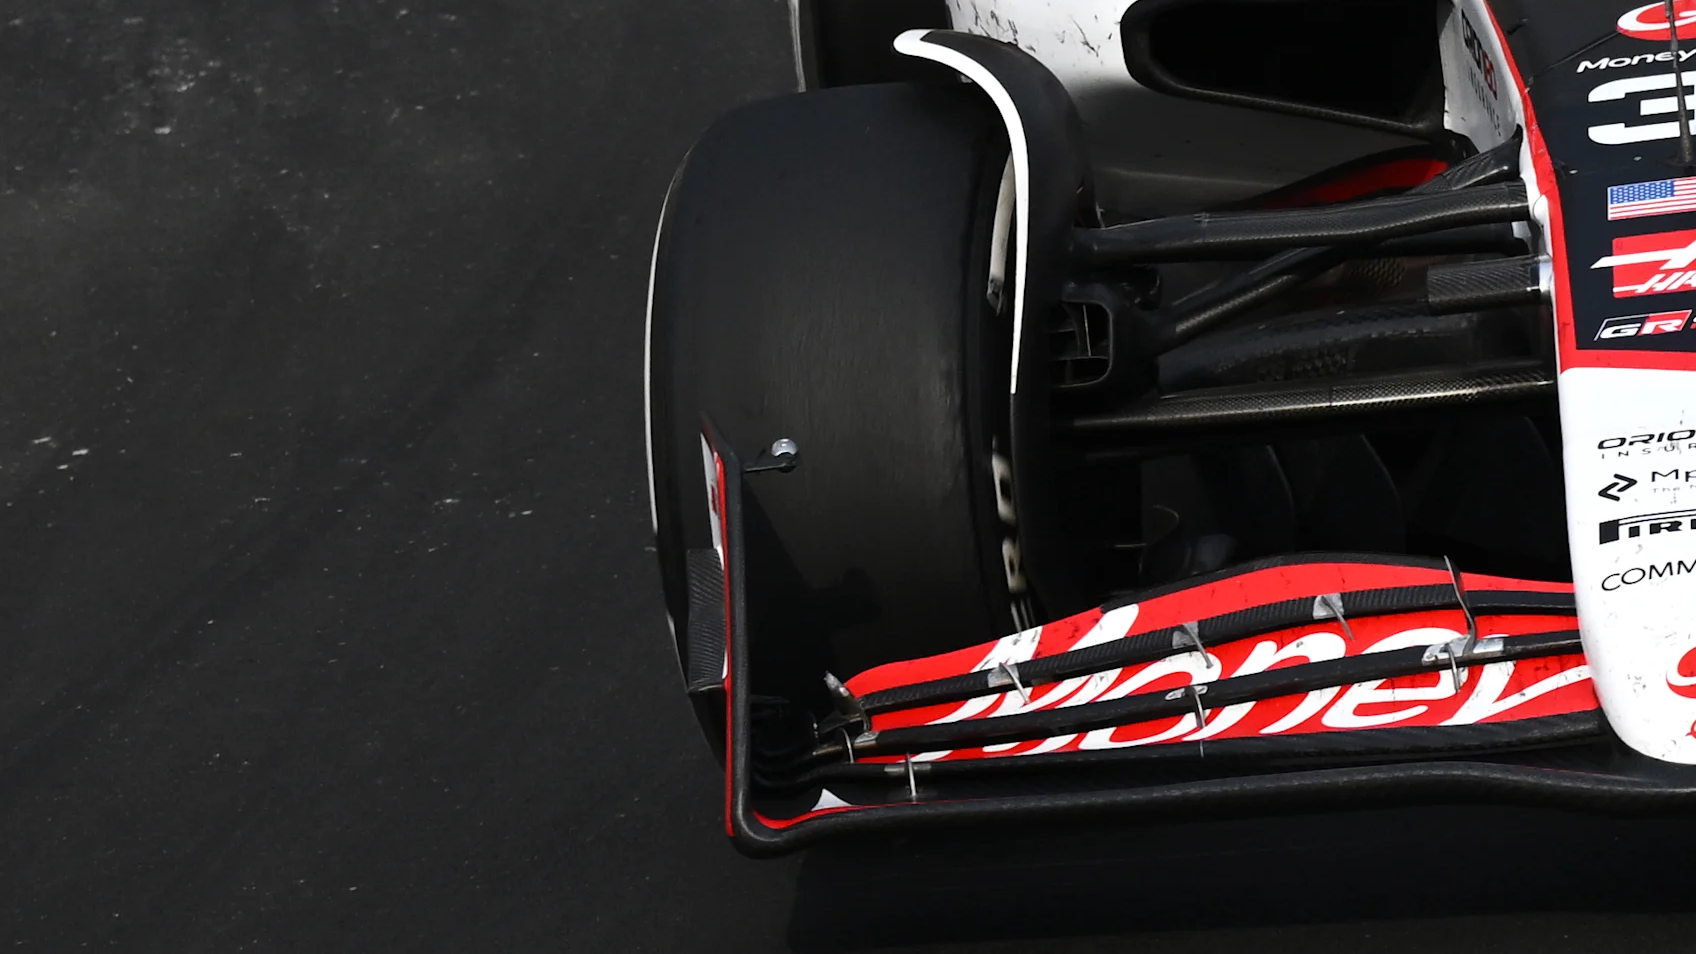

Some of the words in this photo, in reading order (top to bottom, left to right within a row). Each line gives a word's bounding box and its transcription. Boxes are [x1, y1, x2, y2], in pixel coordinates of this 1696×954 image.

[1600, 318, 1685, 340] GR
[1652, 486, 1681, 494] The
[911, 603, 1595, 763] Money
